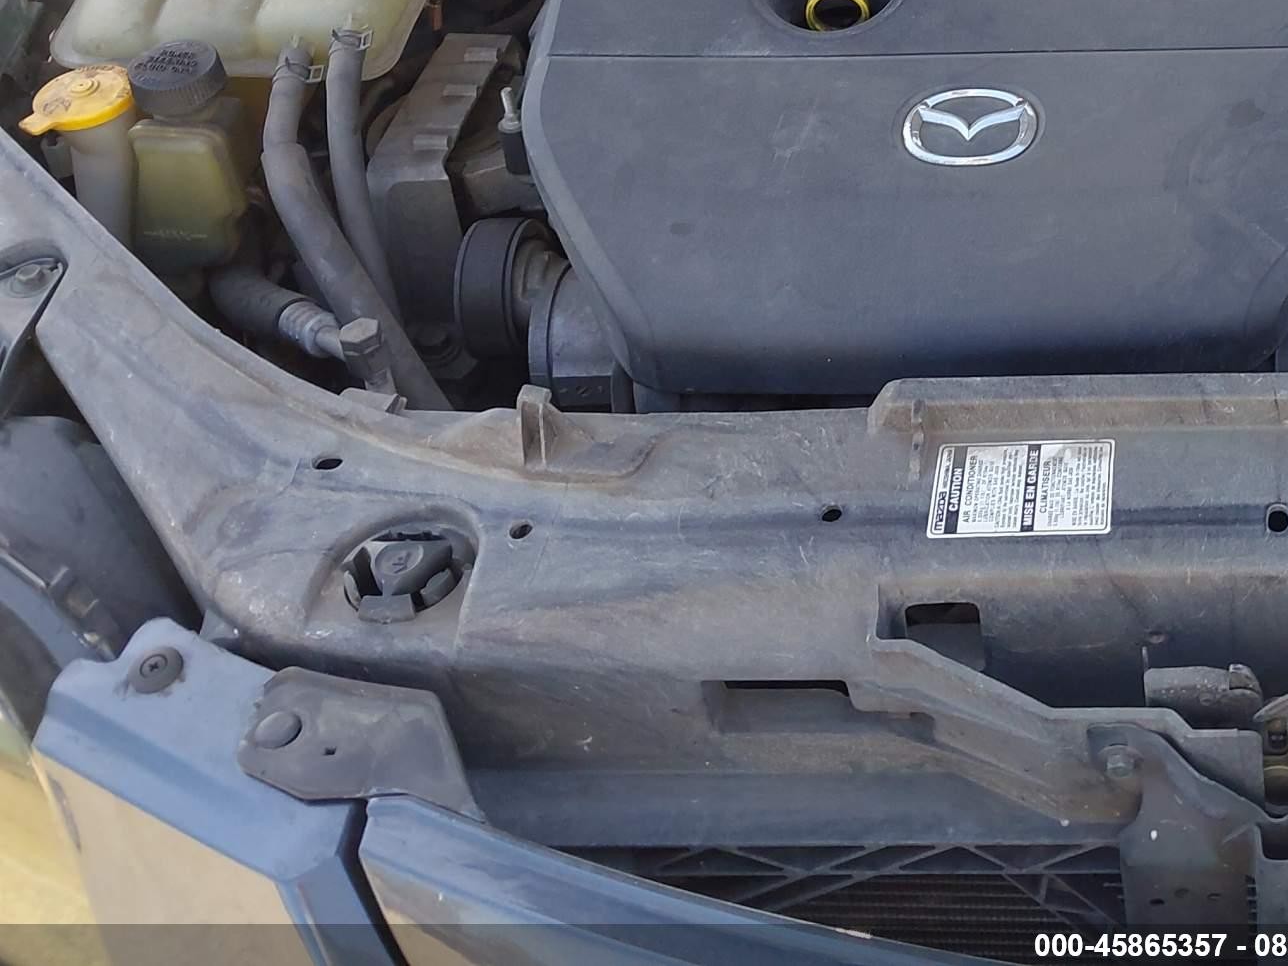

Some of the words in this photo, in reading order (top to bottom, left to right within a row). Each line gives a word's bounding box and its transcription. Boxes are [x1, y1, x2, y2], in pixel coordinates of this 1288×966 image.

[965, 455, 978, 507] CONDITIONER
[1028, 450, 1039, 484] GARDE
[949, 468, 963, 512] CAUTION
[1026, 485, 1036, 500] EN
[1039, 460, 1051, 514] CLIMATISEUR
[962, 510, 971, 523] AIR
[1023, 501, 1034, 526] MISE
